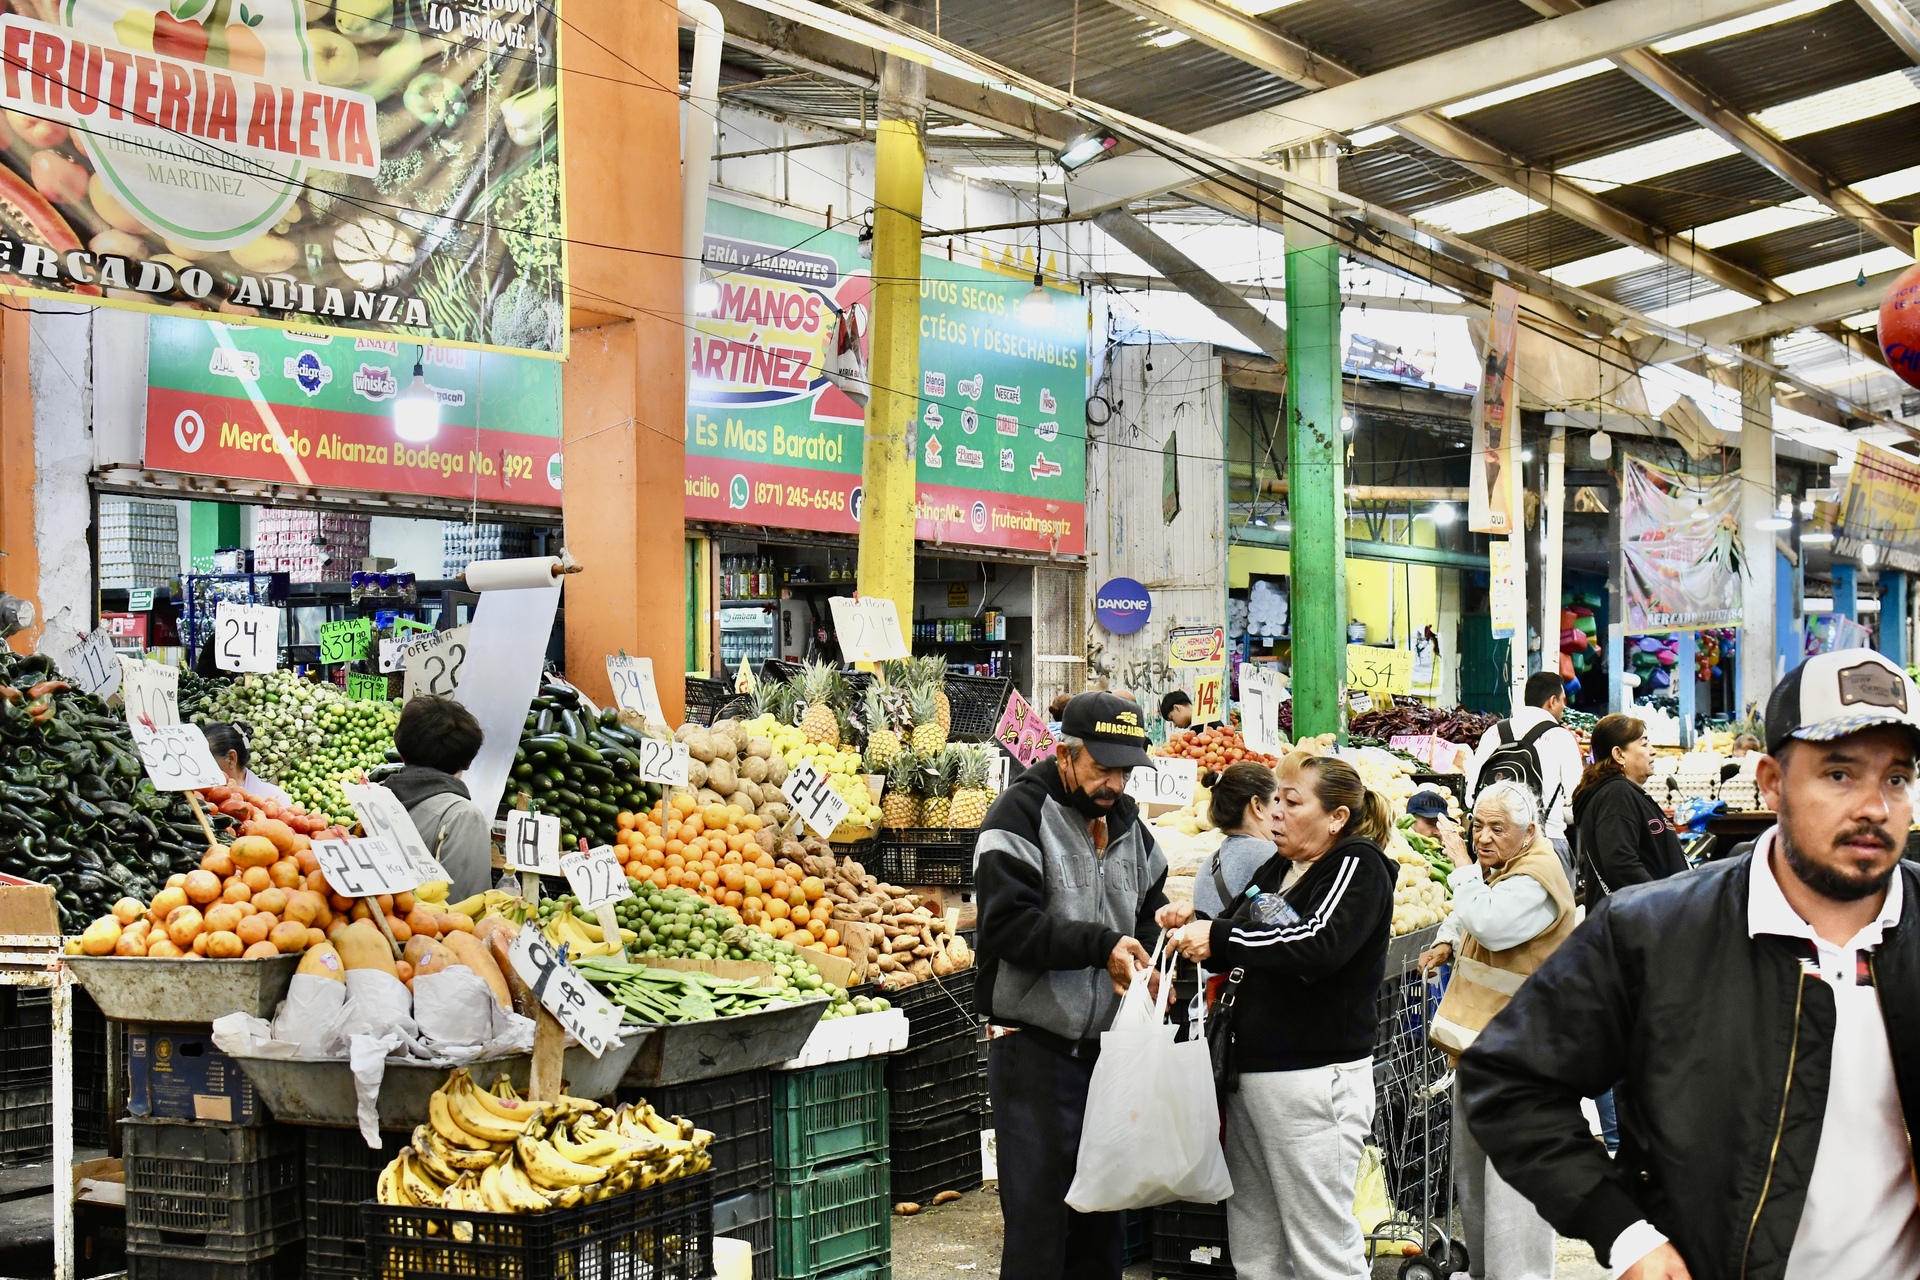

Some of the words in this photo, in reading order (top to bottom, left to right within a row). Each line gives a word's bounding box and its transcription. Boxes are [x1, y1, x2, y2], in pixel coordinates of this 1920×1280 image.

[429, 3, 454, 33] LO
[3, 26, 238, 143] FRUTERIA
[246, 83, 375, 168] ALEYA
[107, 130, 218, 168] HERMANOS
[147, 162, 246, 198] MARTINEZ
[703, 243, 738, 265] ERÍA
[753, 253, 829, 281] ABARROTES
[0, 240, 214, 299] ERCADO
[233, 275, 430, 328] ALIANZA
[920, 276, 957, 305] UTOS
[692, 332, 812, 390] ARTÍNEZ
[919, 313, 967, 346] CTÉOS
[971, 326, 981, 348] Y
[984, 328, 1077, 370] DESECHABLES
[286, 360, 331, 381] Pedigree
[355, 375, 395, 395] whiskas
[219, 422, 311, 458] Mercado
[316, 433, 389, 465] Alianza
[393, 441, 464, 479] Bodega
[469, 455, 497, 477] No.
[502, 455, 533, 480] 492
[696, 414, 718, 447] Es
[724, 418, 767, 454] Mas
[773, 425, 843, 464] Barato!
[685, 475, 720, 499] icilio
[754, 481, 784, 507] (871)
[786, 486, 845, 512] 245-6545
[1097, 598, 1148, 611] DANONE
[224, 618, 258, 657] 24
[320, 619, 362, 634] OFERTA
[1210, 629, 1223, 661] 2
[613, 670, 646, 711] 29
[143, 726, 186, 736] OERTA
[644, 741, 674, 781] 22
[791, 767, 831, 820] 24
[1145, 772, 1176, 797] 40
[323, 843, 390, 893] 24
[576, 859, 622, 906] 22
[525, 917, 577, 978] OFERTN
[556, 1003, 602, 1051] KILO
